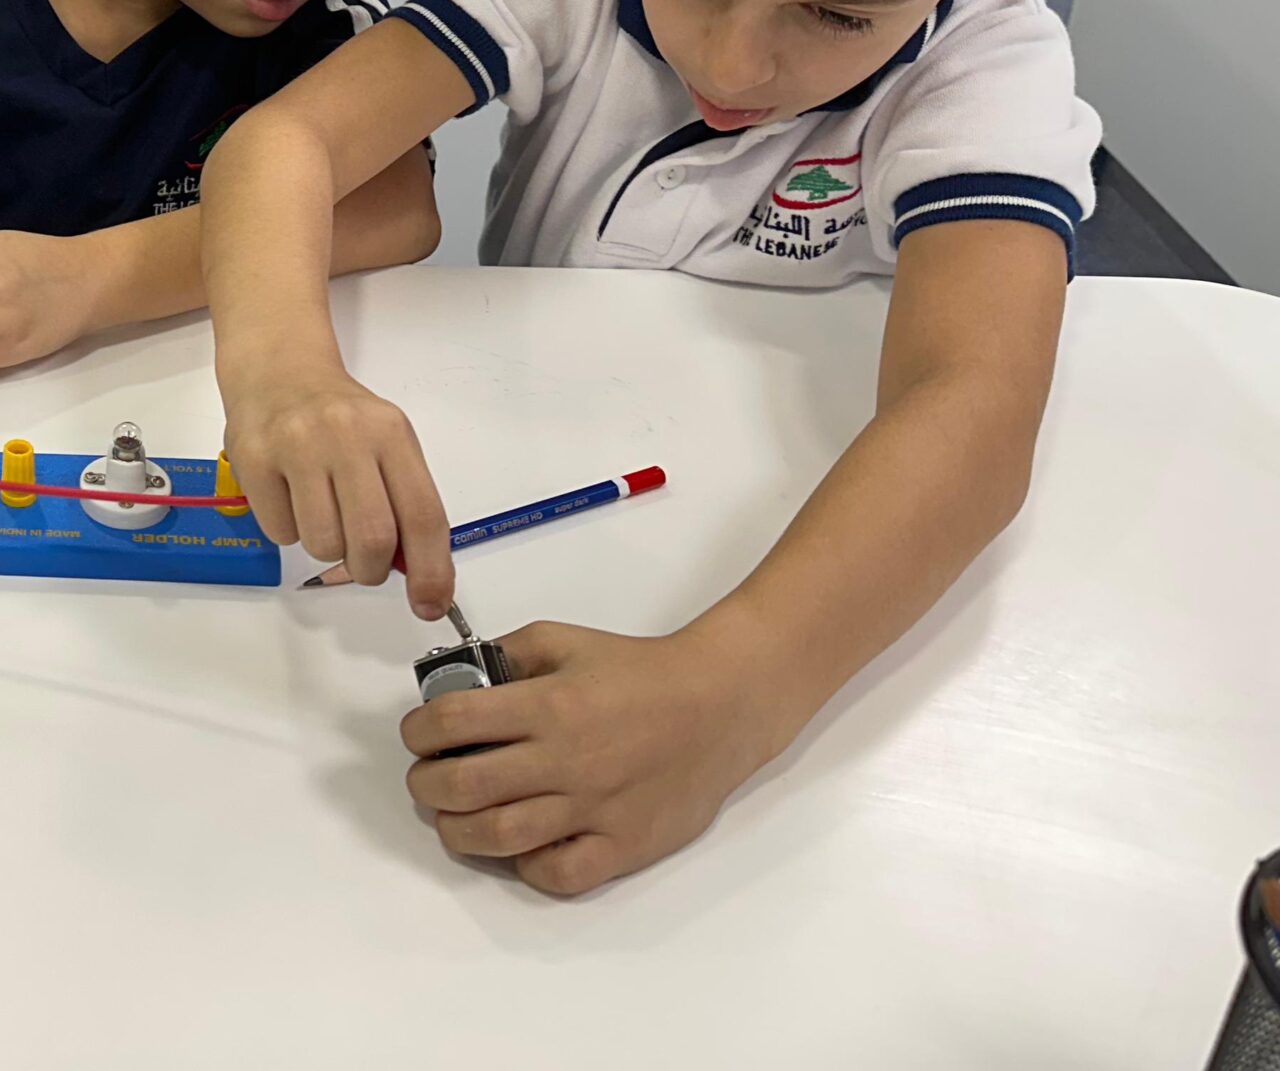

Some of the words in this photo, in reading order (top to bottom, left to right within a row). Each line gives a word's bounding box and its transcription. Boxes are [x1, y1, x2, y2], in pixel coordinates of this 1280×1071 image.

[755, 235, 840, 260] LEBANESE
[30, 529, 43, 537] IN
[45, 530, 81, 539] MADE
[454, 527, 488, 545] camlin
[492, 516, 529, 534] SUPREME
[131, 532, 207, 546] HOLDER
[212, 535, 262, 549] LAMP
